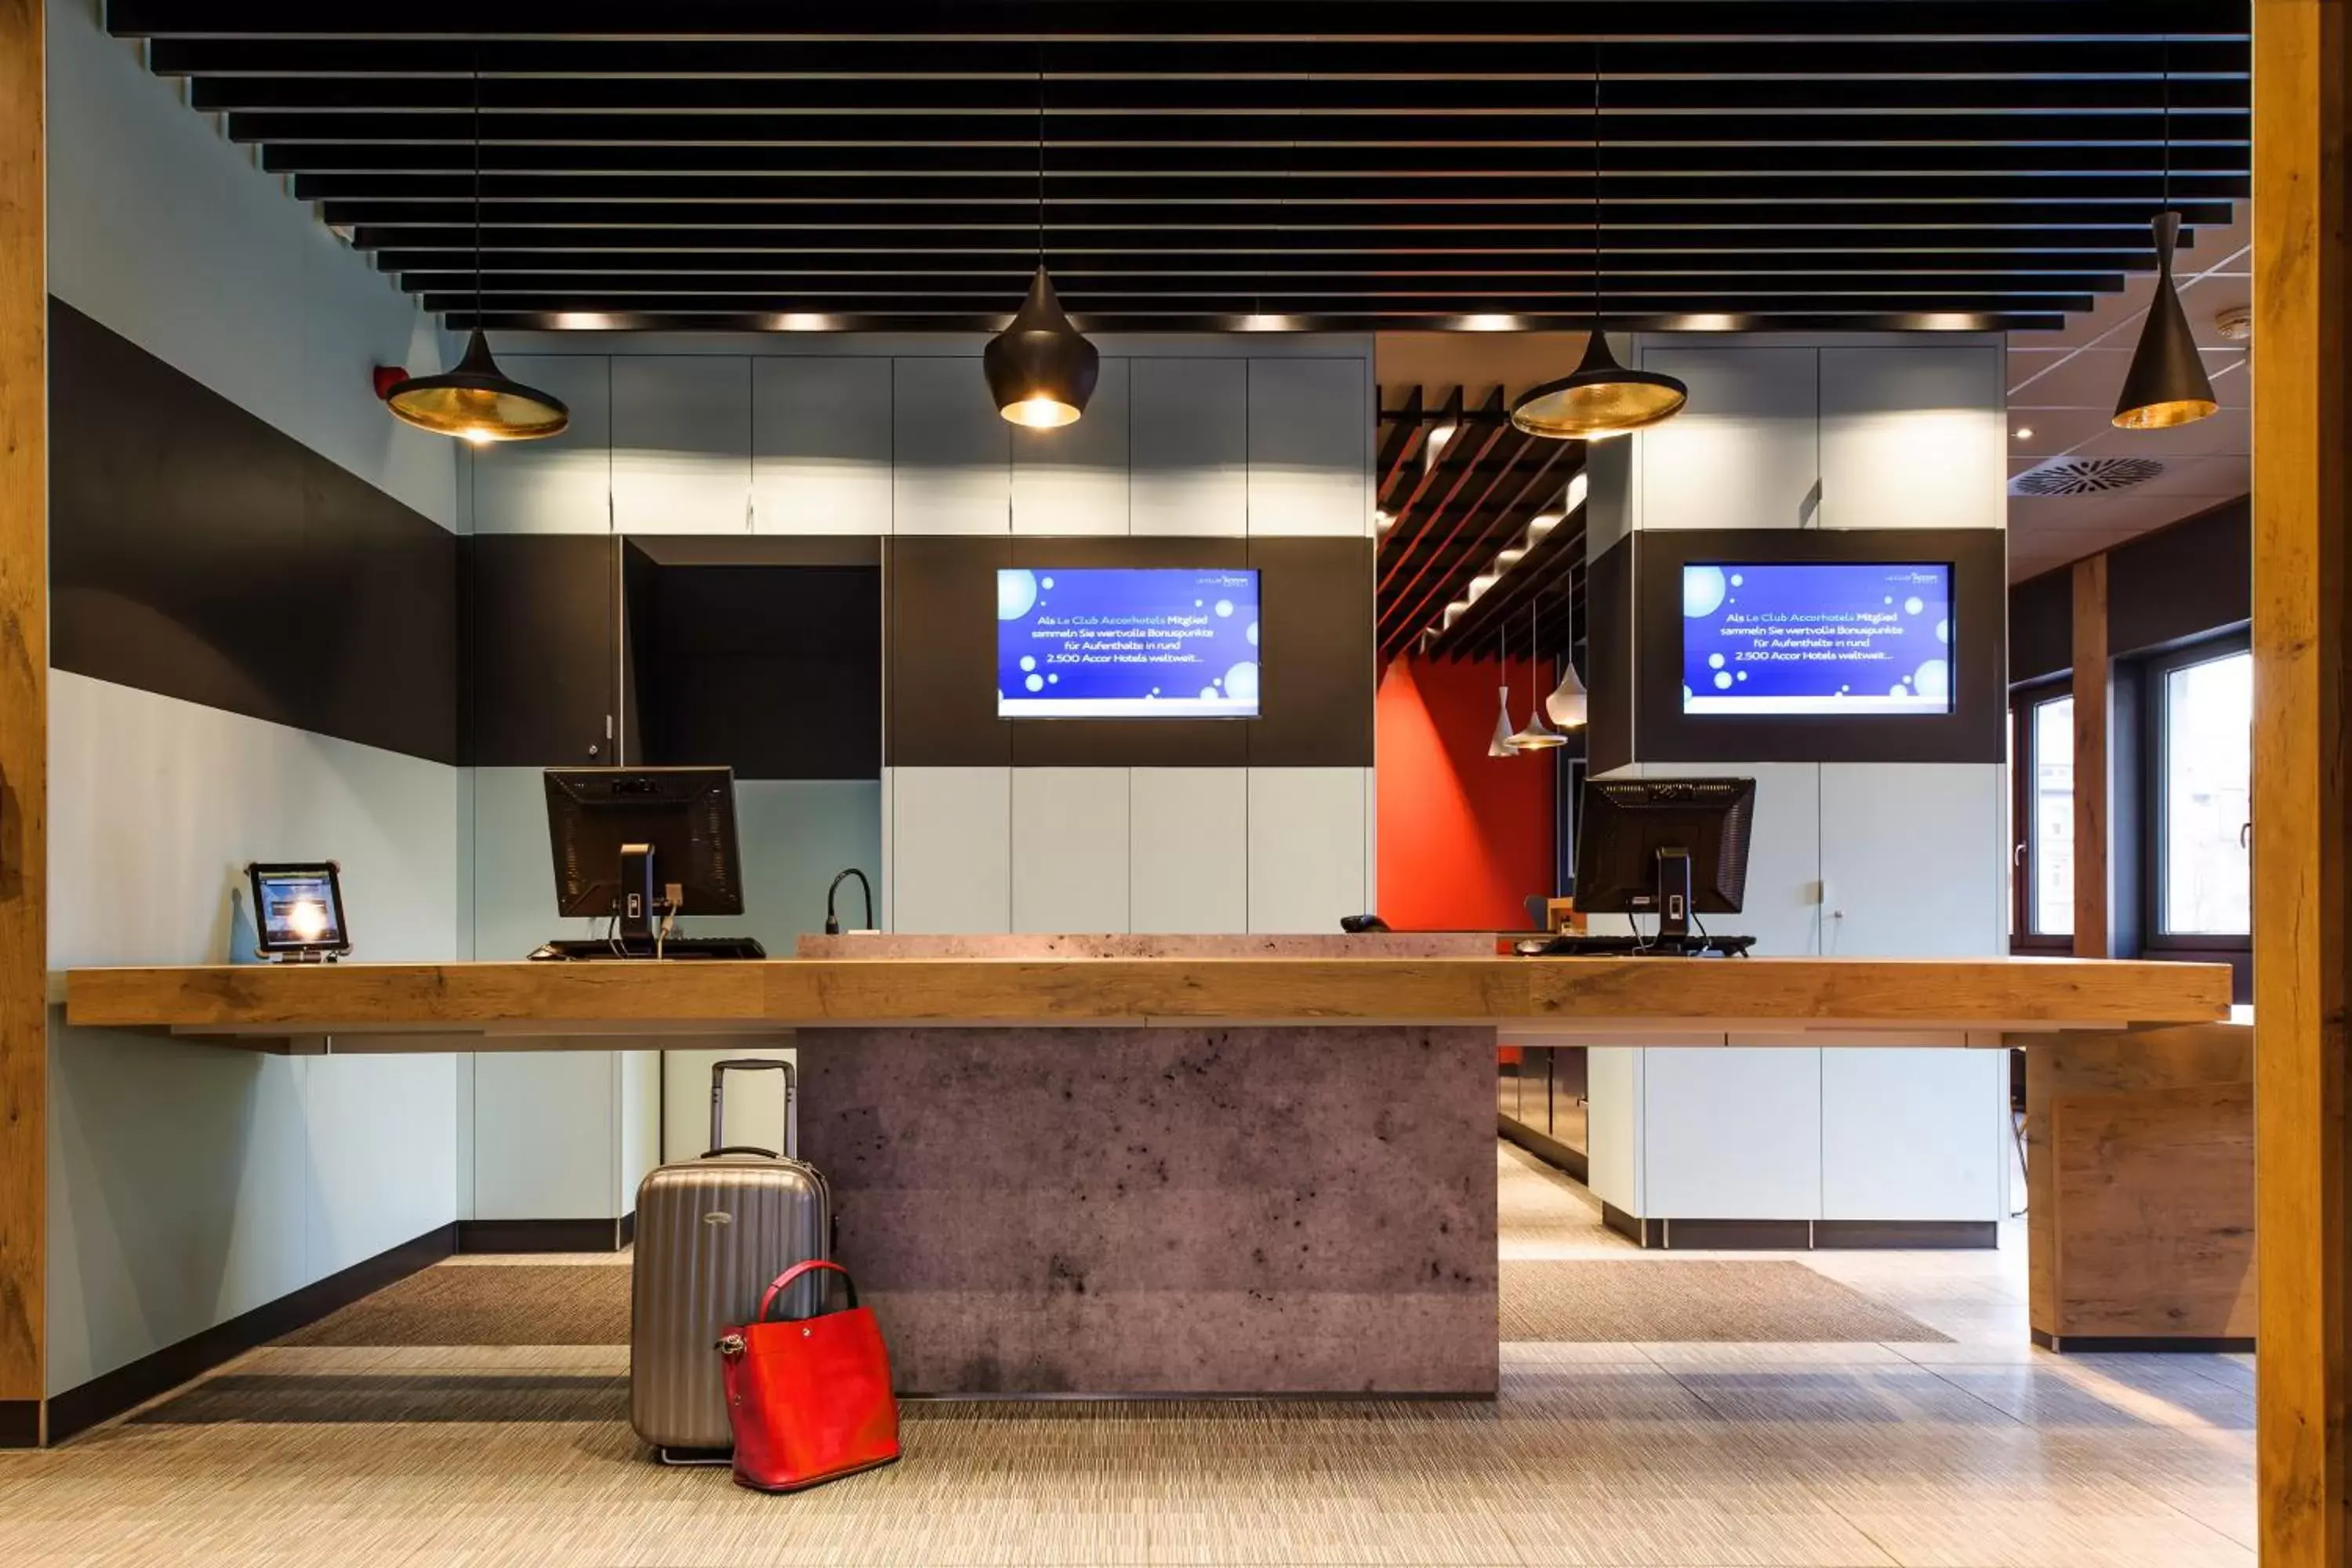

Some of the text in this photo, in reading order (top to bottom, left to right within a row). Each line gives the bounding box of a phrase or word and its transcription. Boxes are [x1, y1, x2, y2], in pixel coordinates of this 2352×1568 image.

[1038, 616, 1055, 625] Als
[1072, 616, 1098, 625] Club
[1167, 615, 1208, 627] Mitglied
[1726, 613, 1744, 622] Als
[1761, 613, 1788, 622] Club
[1857, 612, 1897, 624] Mitglied
[1032, 628, 1214, 638] sammeln Sie wertvolle Bonuspunkte
[1720, 626, 1904, 636] sammeln Sie wertvolle Bonuspunkte
[1082, 641, 1144, 650] Aufenthalte
[1157, 641, 1181, 650] rund
[1771, 638, 1834, 648] Aufenthalte
[1846, 638, 1870, 647] rund
[1047, 654, 1080, 662] 2.500
[1082, 654, 1111, 662] Accor
[1113, 654, 1147, 662] Hotels
[1736, 652, 1769, 660] 2.500
[1771, 652, 1801, 660] Accor
[1802, 651, 1836, 659] Hotels
